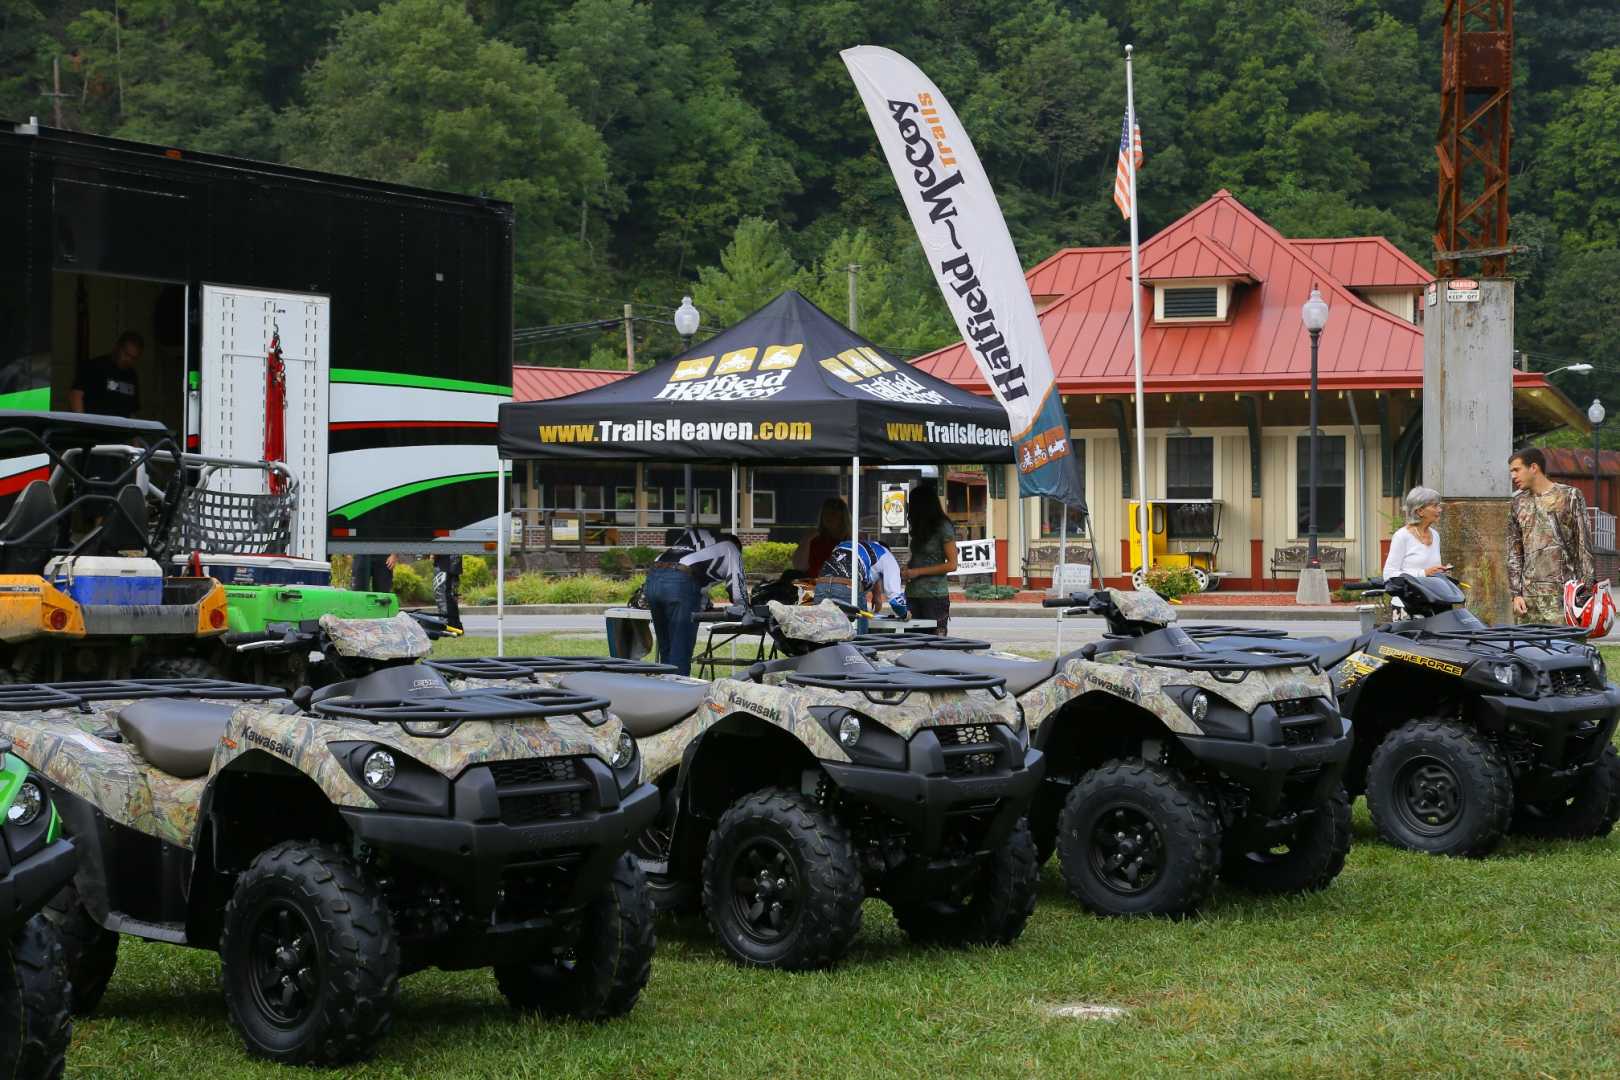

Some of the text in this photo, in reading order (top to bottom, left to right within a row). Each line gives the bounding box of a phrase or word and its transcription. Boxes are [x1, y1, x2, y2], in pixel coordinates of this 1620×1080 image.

[918, 92, 957, 168] Trails
[653, 370, 792, 399] Hatfield
[539, 419, 812, 442] www.TrailsHeaven.com
[1086, 671, 1137, 700] Kawasaki
[728, 690, 781, 722] Kawasaki
[241, 725, 294, 758] Kawasaki
